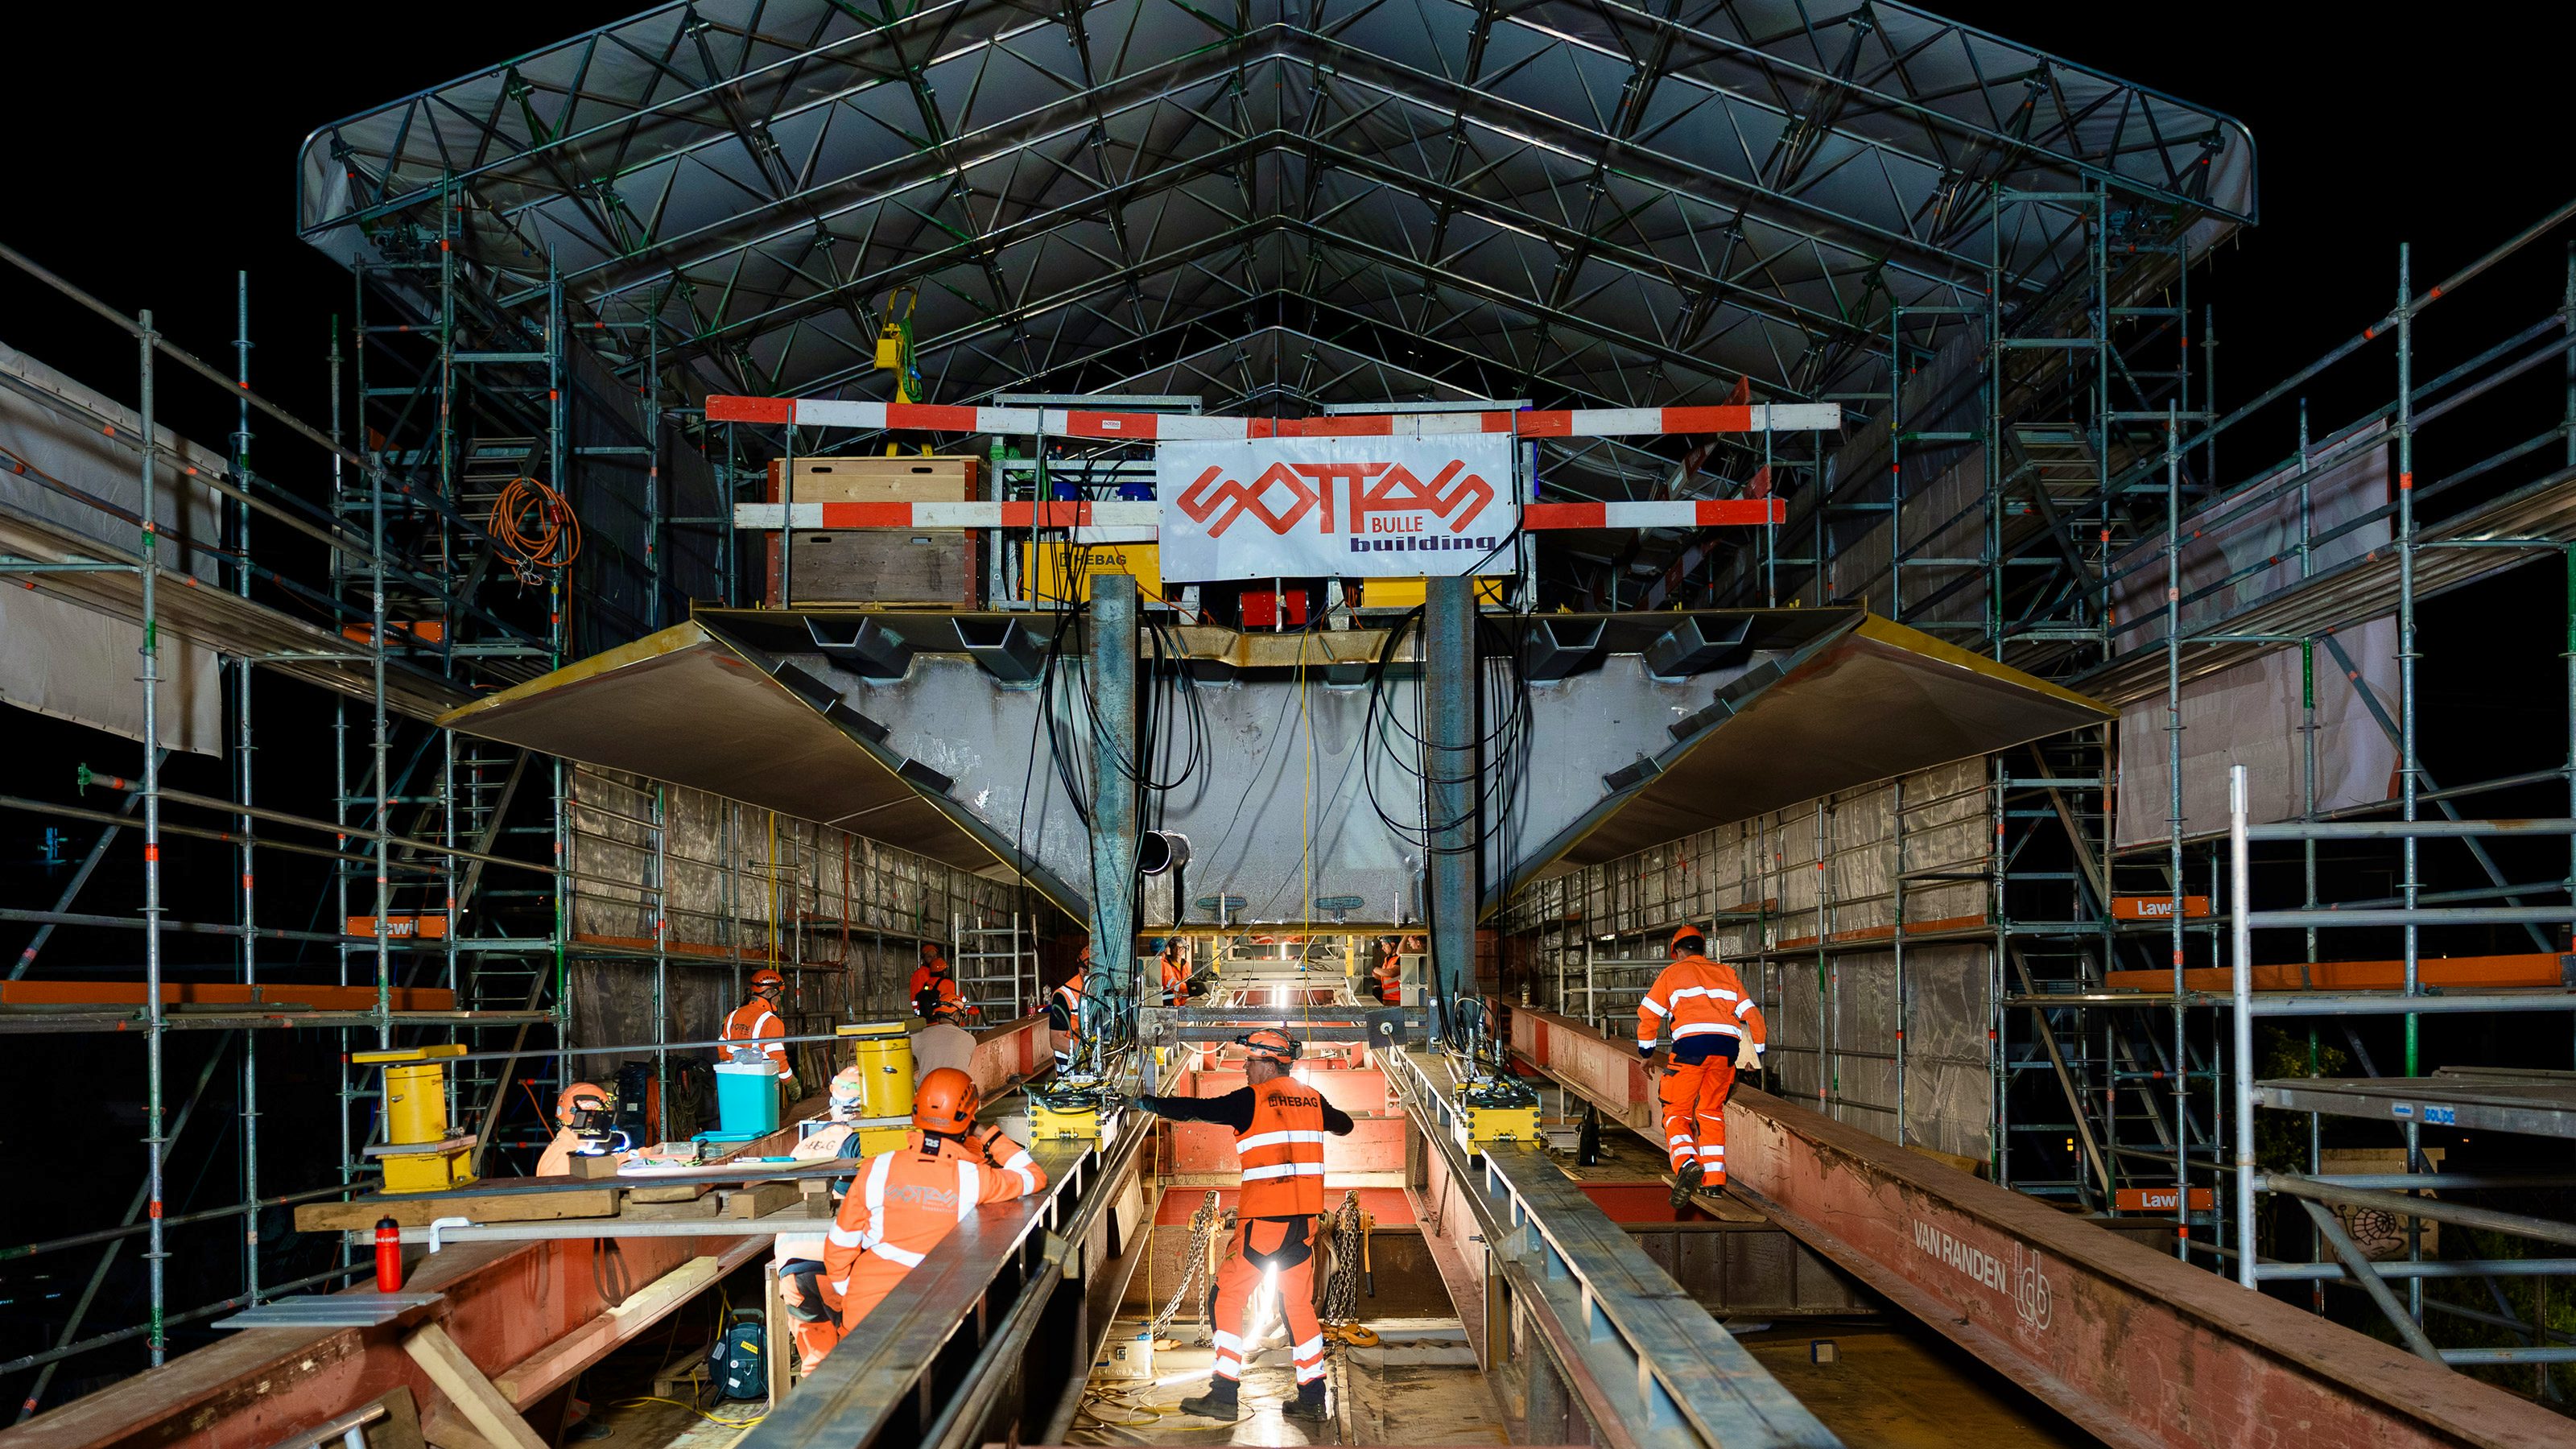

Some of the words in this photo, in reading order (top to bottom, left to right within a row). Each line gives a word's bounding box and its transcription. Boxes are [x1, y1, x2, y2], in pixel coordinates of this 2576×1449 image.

[1176, 459, 1495, 539] SOTTAS
[1372, 516, 1423, 534] BULLE
[1350, 535, 1496, 553] building
[1074, 553, 1127, 566] HEBAG
[2137, 900, 2174, 916] Law
[1278, 1096, 1319, 1108] HEBAG
[884, 1183, 959, 1208] SOTTAS
[2141, 1191, 2179, 1208] Lawi
[1913, 1218, 1940, 1259] VAN
[1942, 1233, 2007, 1294] RANDEN
